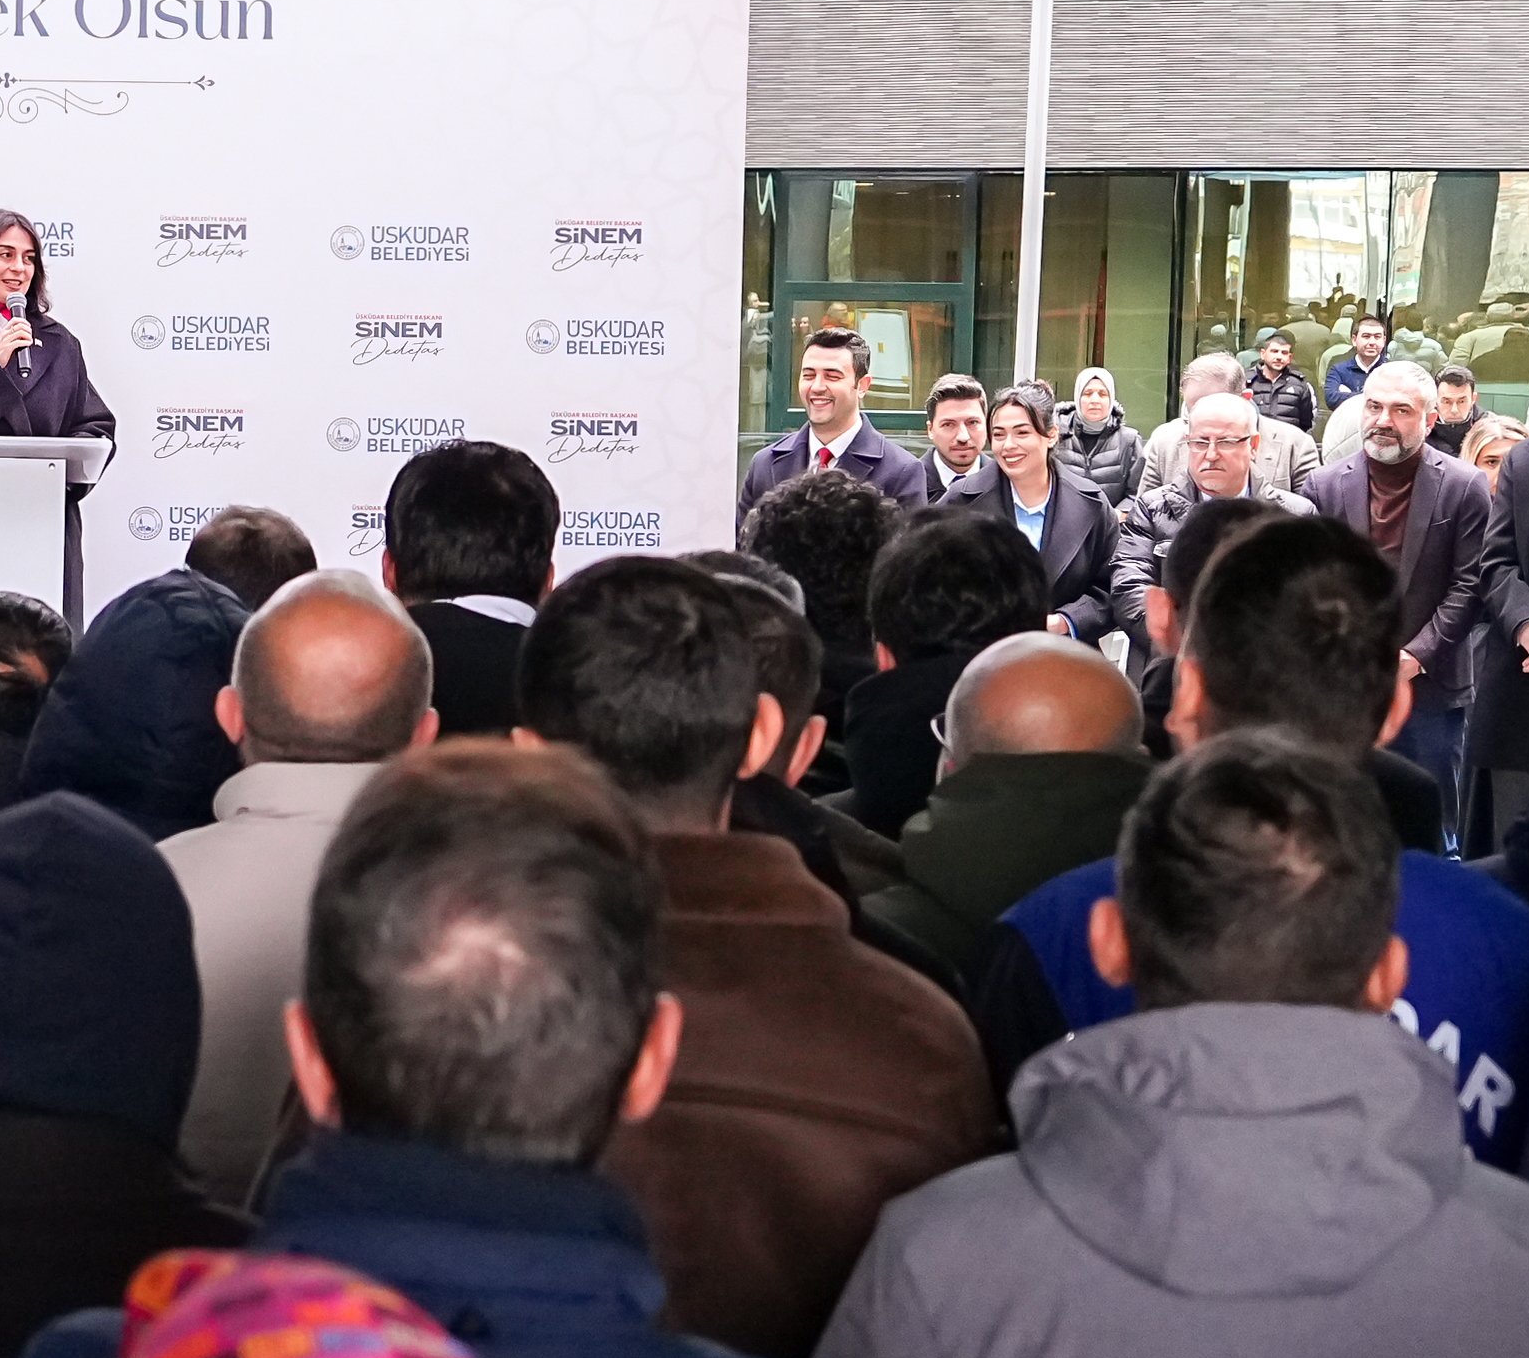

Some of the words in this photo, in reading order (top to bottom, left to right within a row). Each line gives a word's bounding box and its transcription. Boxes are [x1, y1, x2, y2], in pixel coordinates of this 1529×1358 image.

[371, 225, 469, 245] ÜSKÜDAR
[172, 315, 270, 335] ÜSKÜDAR
[566, 319, 664, 339] ÜSKÜDAR
[367, 417, 465, 437] ÜSKÜDAR
[562, 510, 660, 530] ÜSKÜDAR
